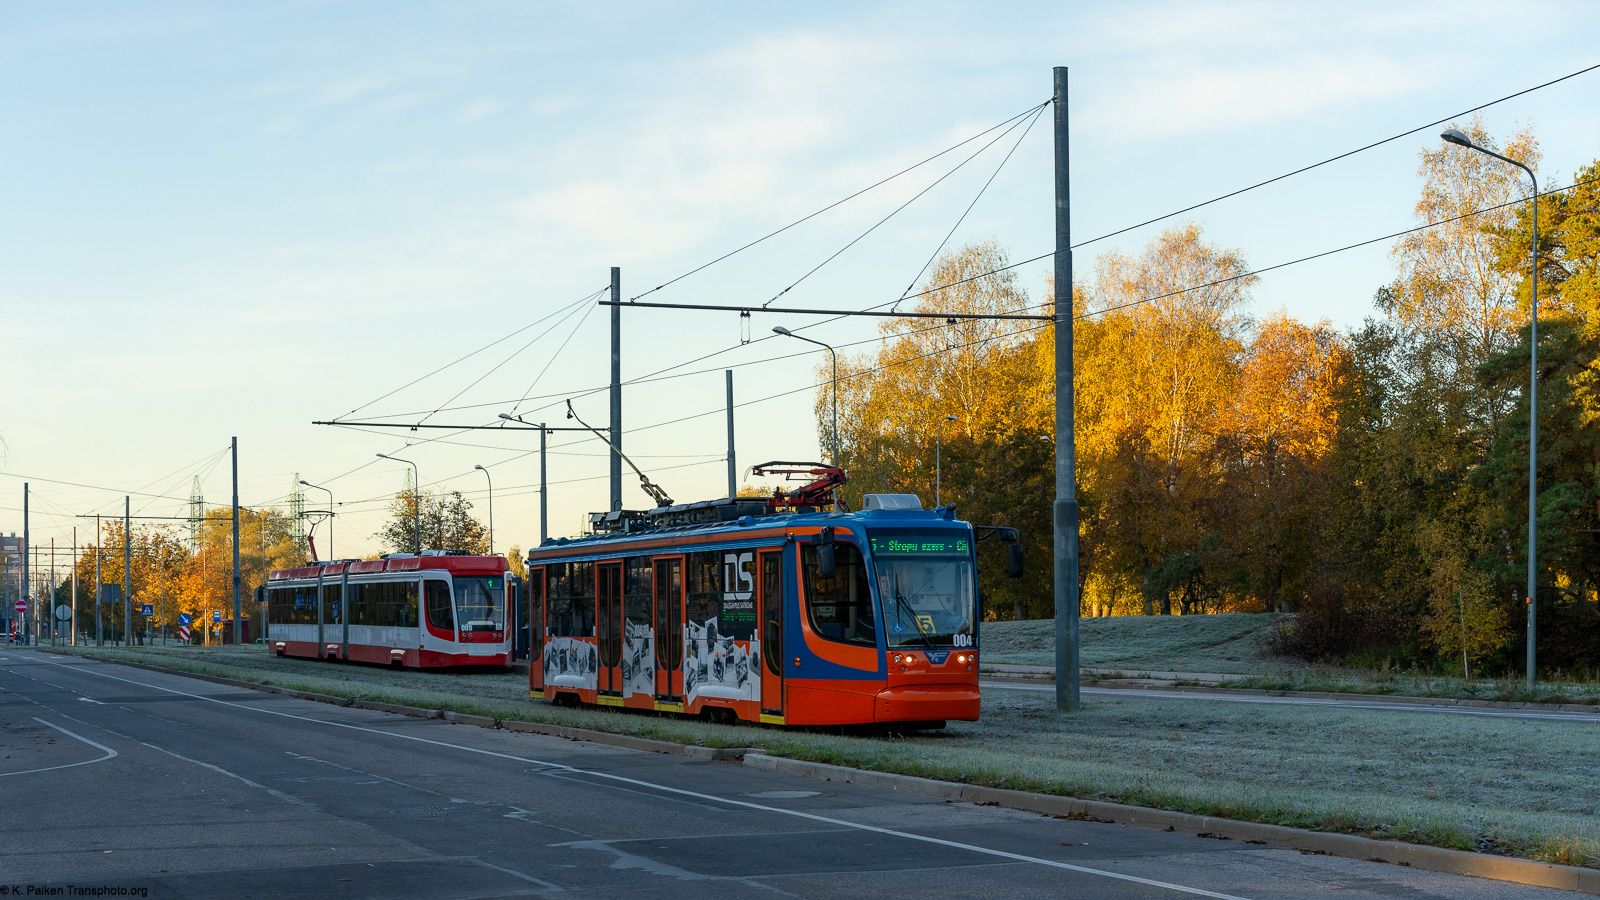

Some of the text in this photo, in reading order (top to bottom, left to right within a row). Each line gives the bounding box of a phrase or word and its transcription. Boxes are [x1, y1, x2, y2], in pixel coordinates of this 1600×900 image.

[888, 540, 918, 553] Stropu
[488, 580, 493, 588] 1
[920, 617, 934, 634] 5
[953, 634, 973, 647] 004
